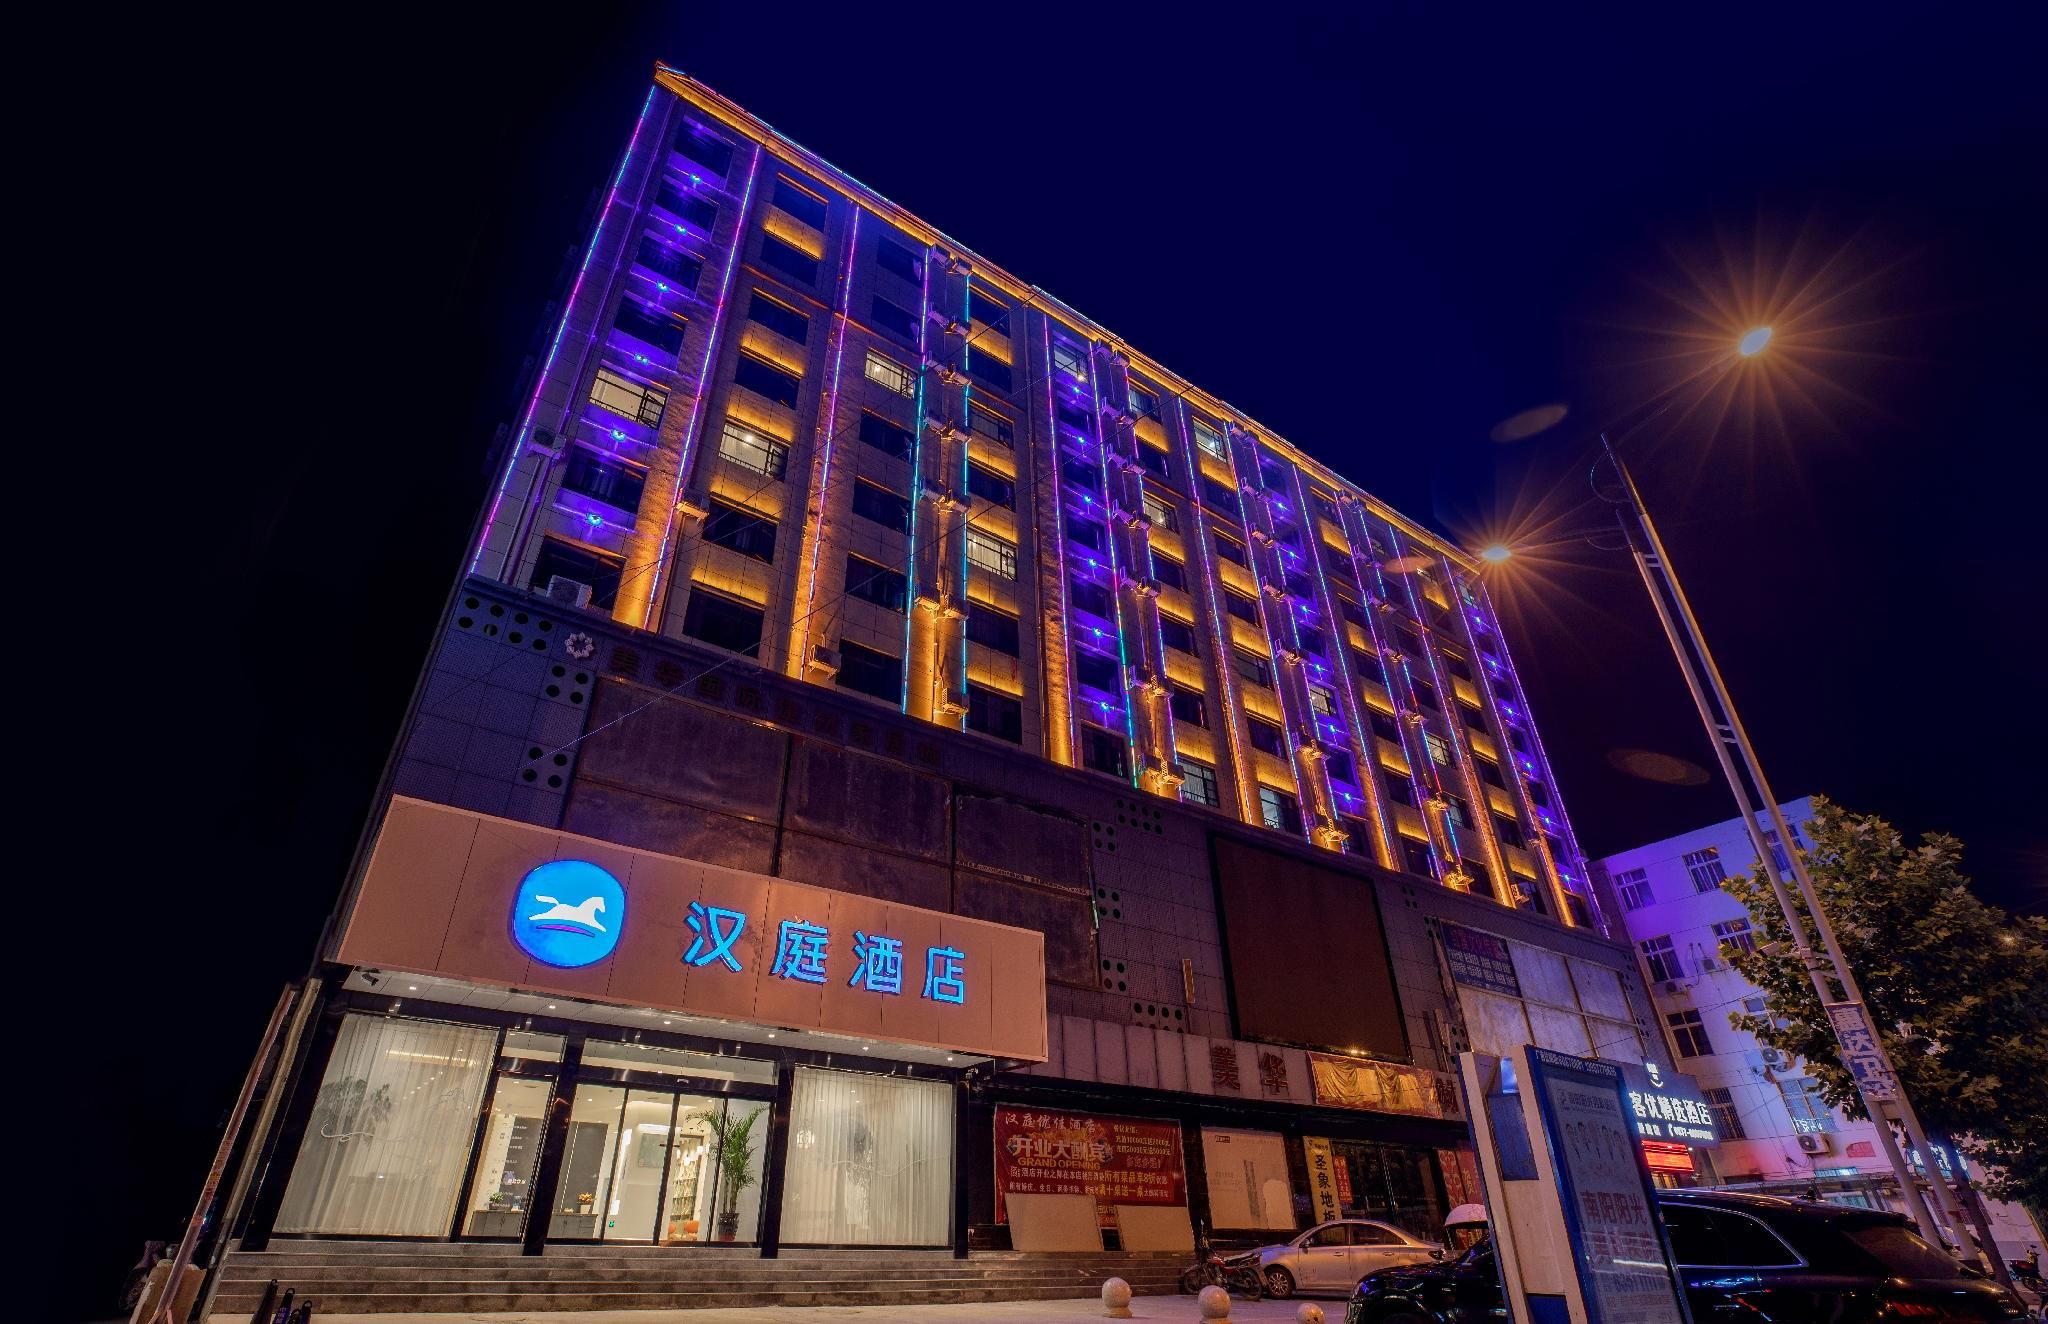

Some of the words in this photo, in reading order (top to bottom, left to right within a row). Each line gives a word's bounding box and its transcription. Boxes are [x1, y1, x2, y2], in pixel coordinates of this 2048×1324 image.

[683, 900, 967, 1006] 汉庭酒店
[1013, 1137, 1106, 1162] 开业大酬宾
[1017, 1157, 1057, 1168] GRAND
[1058, 1159, 1101, 1171] OPENING
[1313, 1154, 1336, 1224] 圣象地板
